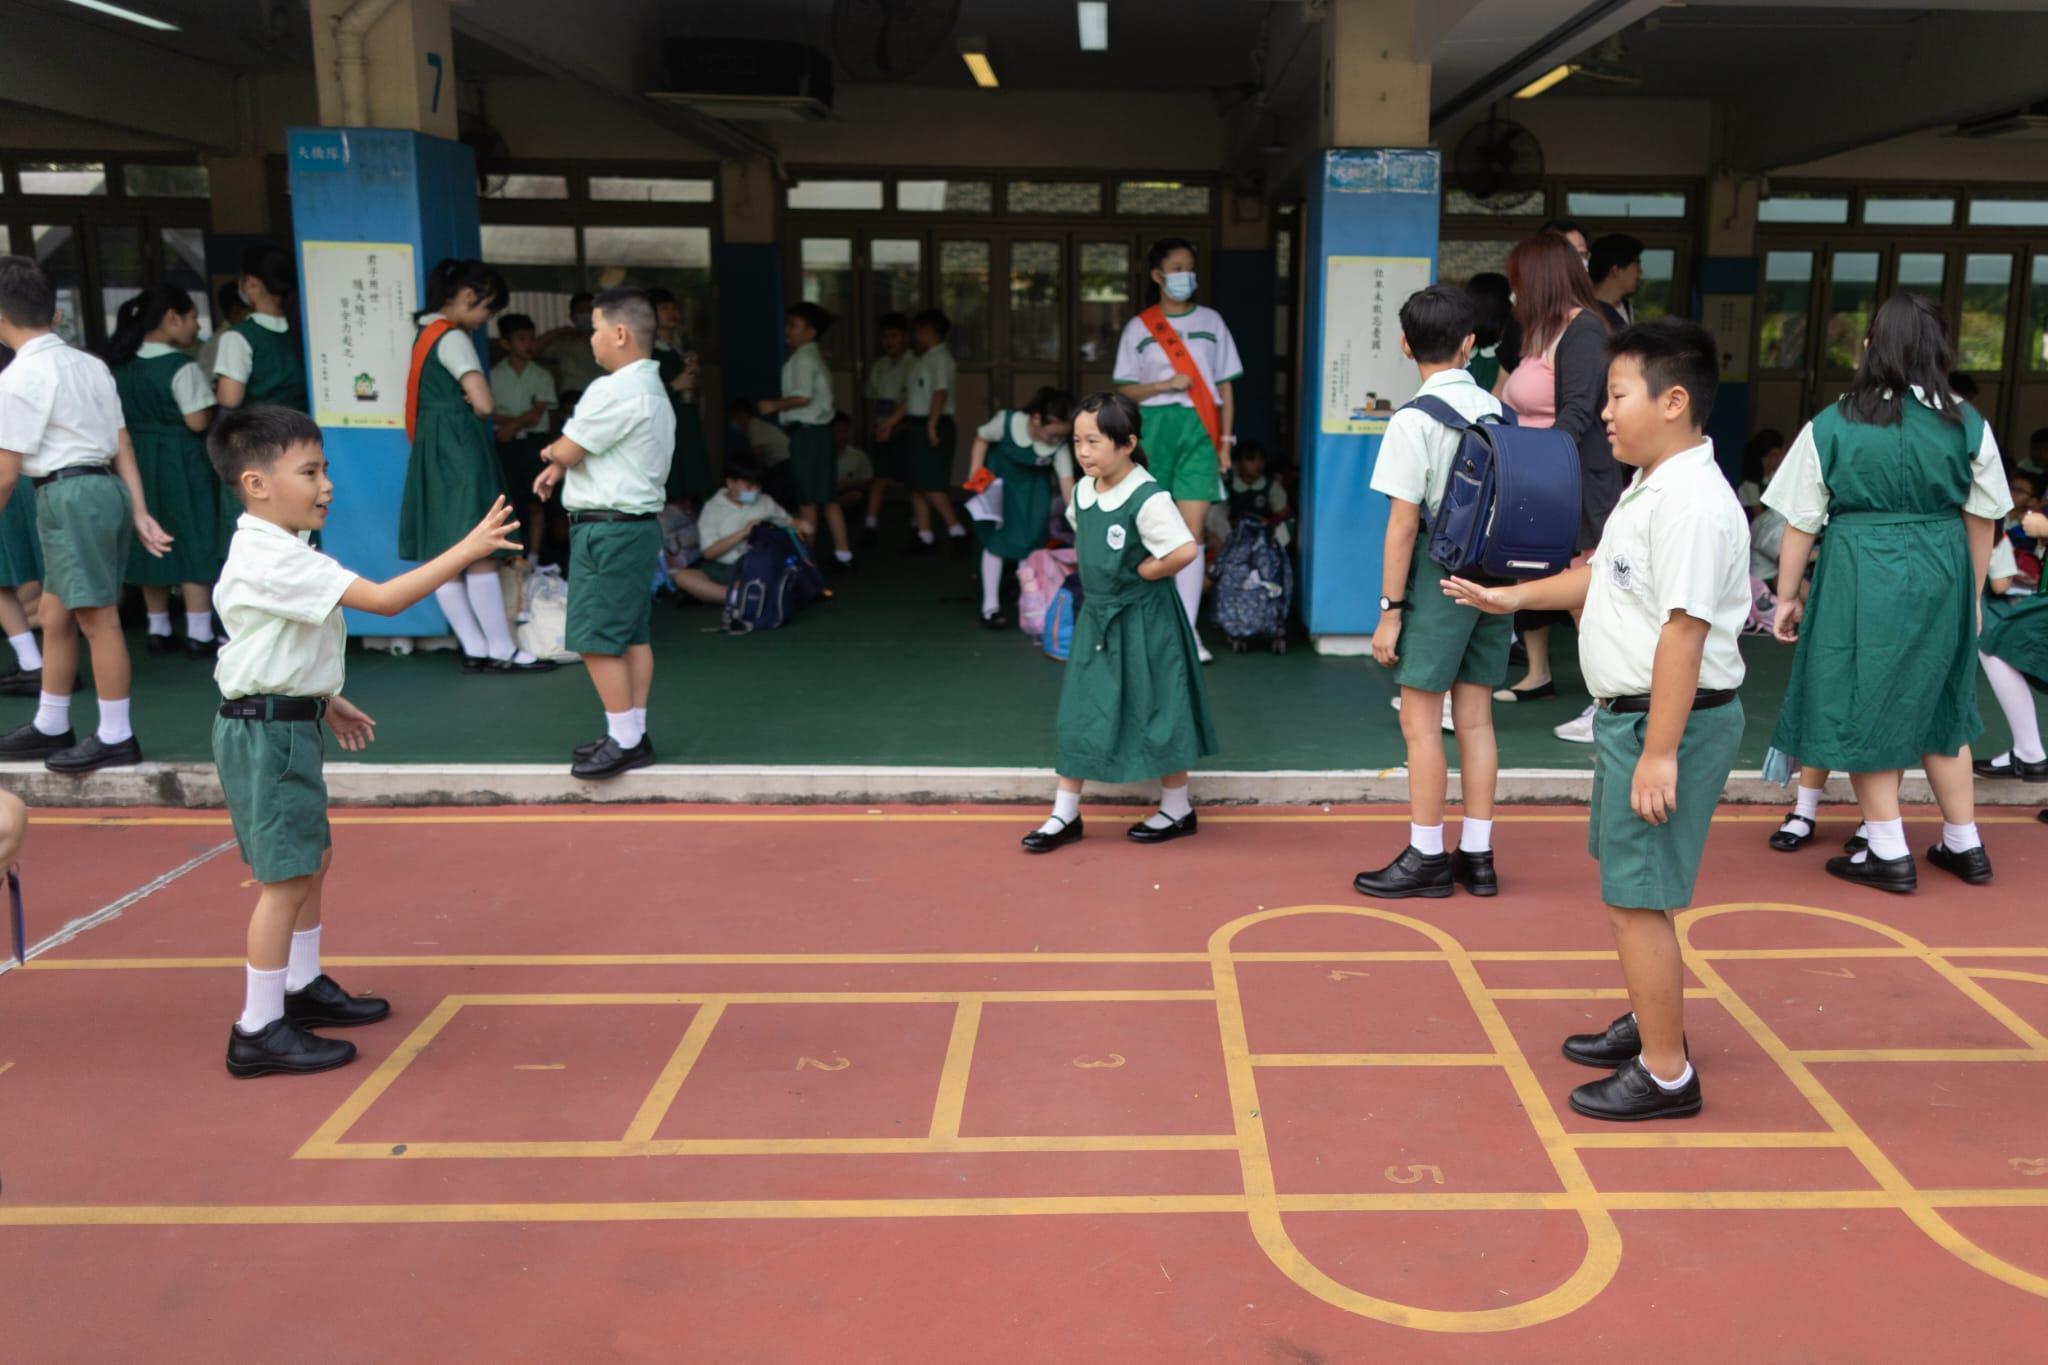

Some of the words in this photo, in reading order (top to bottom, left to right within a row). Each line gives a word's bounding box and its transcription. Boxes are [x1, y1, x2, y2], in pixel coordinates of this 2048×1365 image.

[426, 52, 443, 113] 7
[796, 1056, 851, 1071] 2
[1072, 1053, 1126, 1069] 3
[1384, 1164, 1445, 1185] 5
